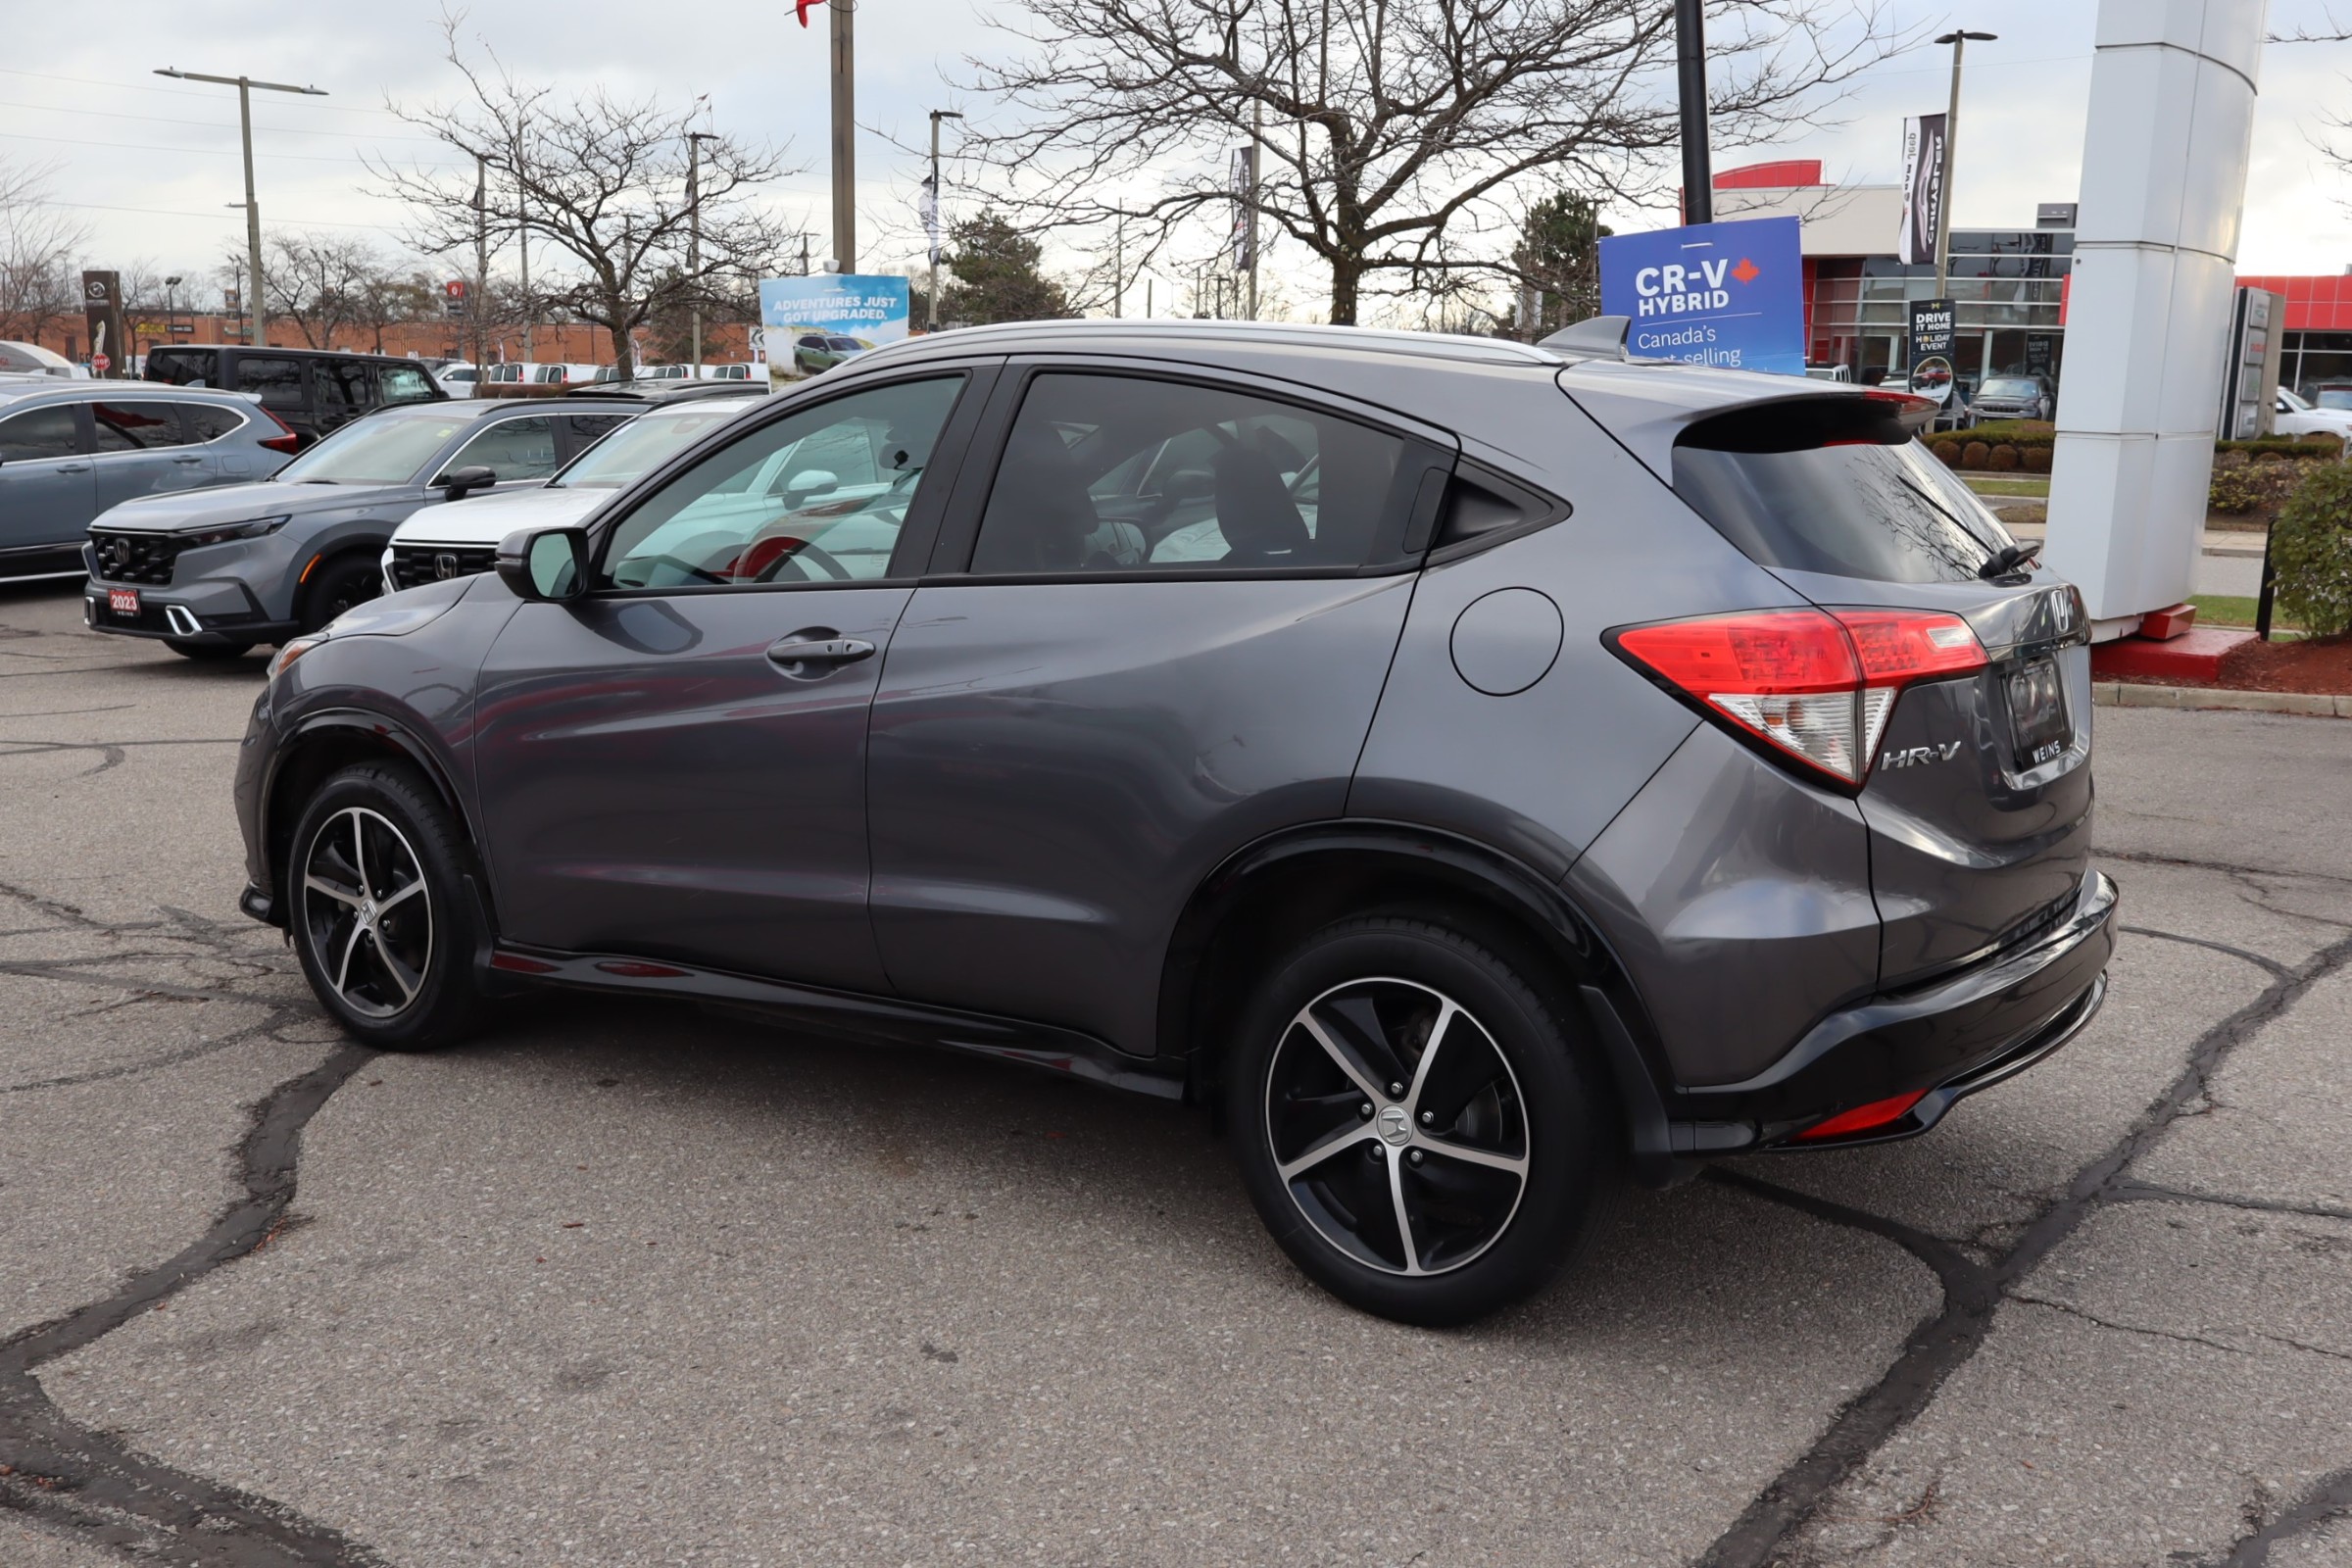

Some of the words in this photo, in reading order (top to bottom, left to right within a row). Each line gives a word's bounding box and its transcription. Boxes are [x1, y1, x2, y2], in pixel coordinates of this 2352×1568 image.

[1636, 259, 1729, 297] CR-V
[773, 296, 861, 311] ADVENTURES
[863, 297, 897, 308] JUST
[1639, 290, 1729, 317] HYBRID
[783, 311, 810, 322] GOT
[812, 309, 888, 321] UPGRADED.
[1916, 312, 1951, 323] DRIVE
[1927, 322, 1950, 331] HOME
[1921, 342, 1947, 351] EVENT
[111, 594, 137, 611] 2023
[1881, 741, 1961, 770] HR-V
[2032, 740, 2061, 763] WEINS
